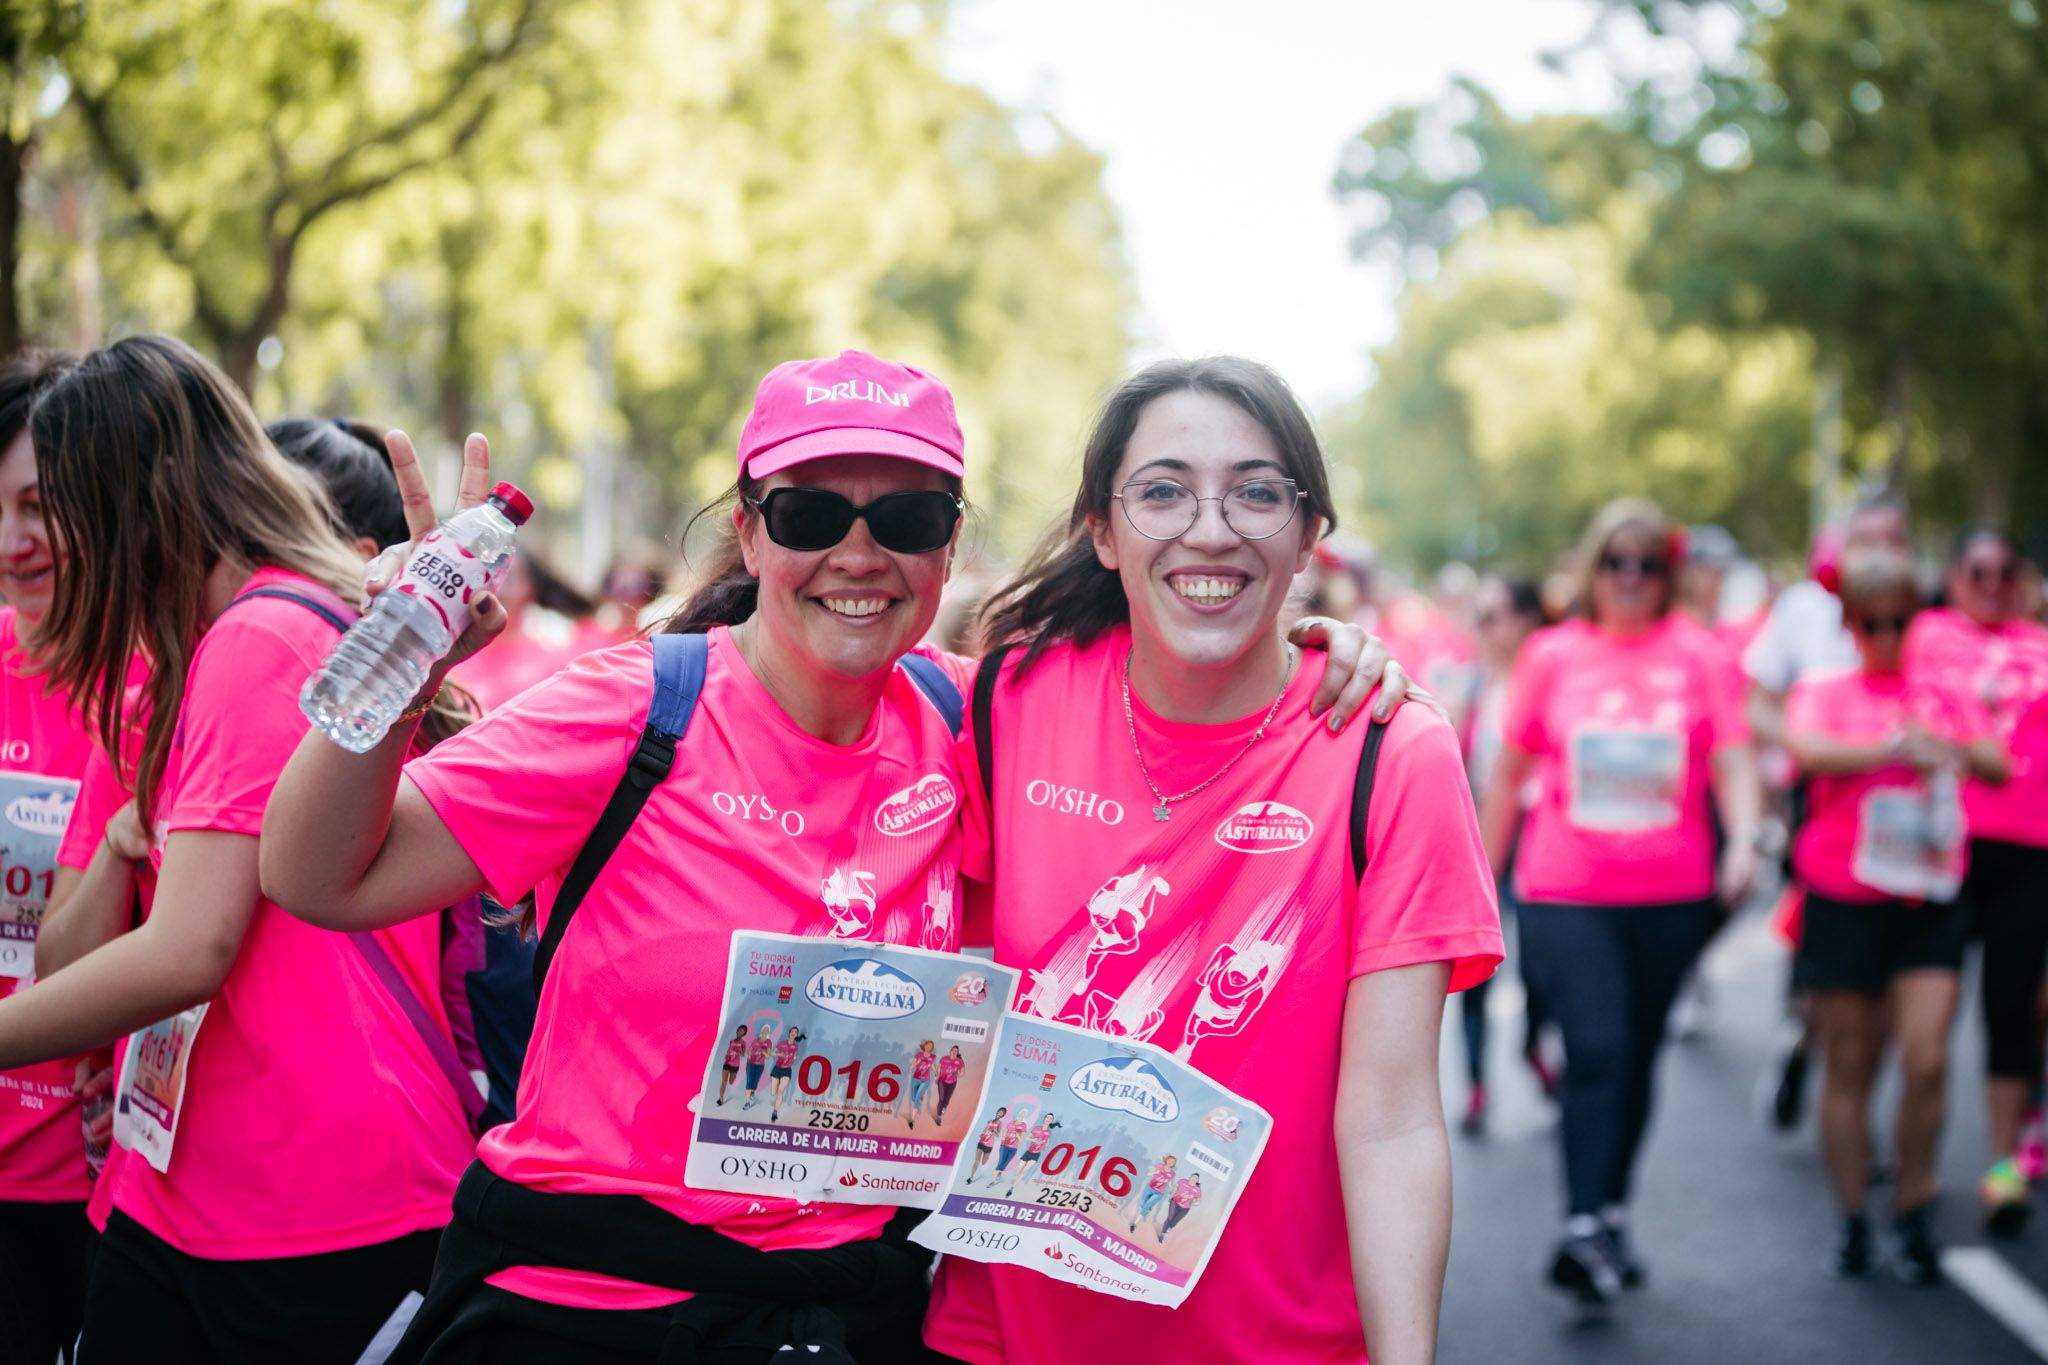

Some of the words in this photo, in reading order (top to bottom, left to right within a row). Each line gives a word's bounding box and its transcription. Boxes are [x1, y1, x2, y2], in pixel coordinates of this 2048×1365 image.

[805, 379, 911, 408] DRUNI
[409, 561, 456, 599] SODIO
[418, 551, 464, 588] ZERO
[712, 791, 805, 837] OYSO
[1026, 779, 1125, 826] OYSHO
[1220, 821, 1305, 841] ASTURIANA
[749, 961, 792, 978] SUMA
[811, 975, 916, 1010] ASTURIANA
[1012, 1043, 1057, 1066] SUMA
[797, 1055, 902, 1103] 016
[1074, 1070, 1169, 1118] ASTURIANA
[808, 1109, 870, 1132] 25230
[728, 1125, 789, 1145] CARRERA
[793, 1132, 809, 1147] DE
[813, 1135, 831, 1150] LA
[835, 1137, 879, 1154] MUJER
[889, 1142, 943, 1159] MADRID
[721, 1156, 808, 1182] OYSHO
[861, 1173, 940, 1193] Santander
[1040, 1142, 1138, 1198] 016
[1036, 1187, 1093, 1213] 25243
[946, 1227, 1020, 1251] OYSHO
[965, 1200, 1015, 1219] CARRERA
[1016, 1207, 1033, 1221] DE
[1034, 1210, 1050, 1224] LA
[1051, 1212, 1095, 1240] MUJER
[1102, 1236, 1159, 1274] MADRID
[1064, 1253, 1150, 1296] Santander
